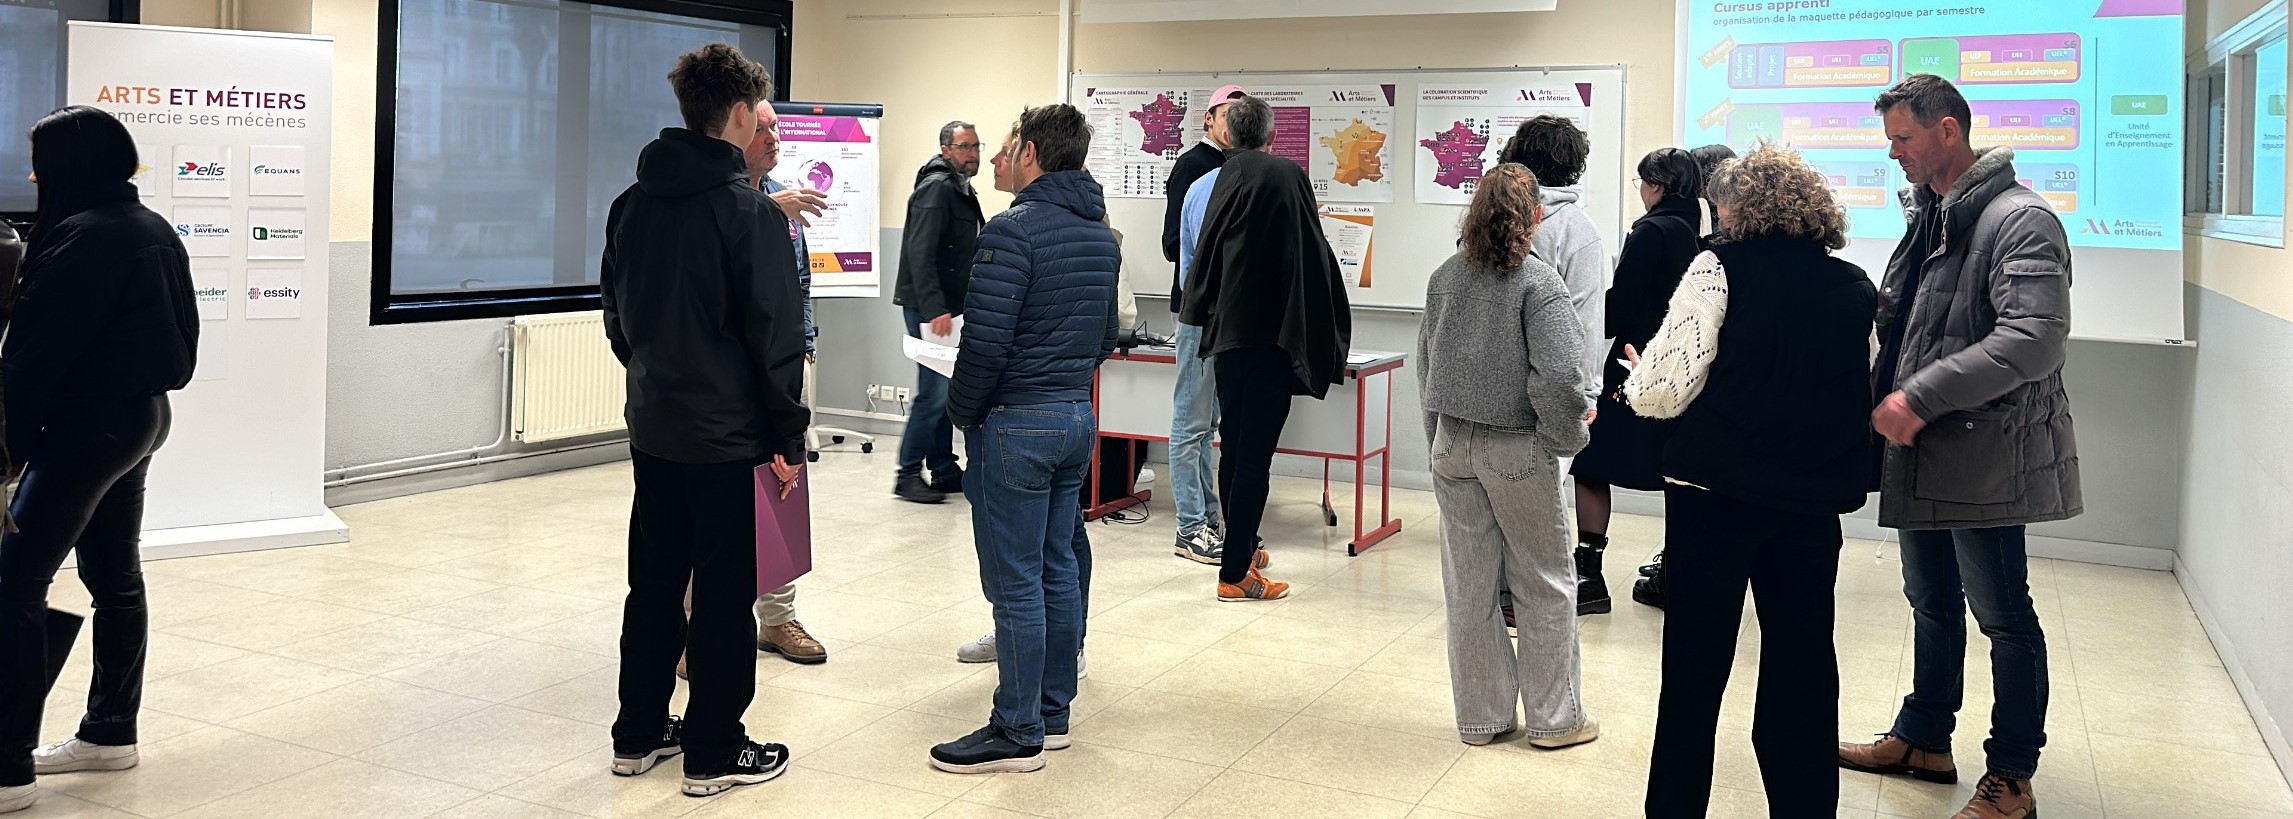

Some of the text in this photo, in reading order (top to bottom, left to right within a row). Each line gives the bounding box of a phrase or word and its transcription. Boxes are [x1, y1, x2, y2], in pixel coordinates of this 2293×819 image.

[1713, 2, 1763, 13] Cursus
[1713, 6, 1986, 27] organisation de la maquette pédagogique par semestre
[2063, 40, 2077, 49] S6
[1876, 46, 1889, 54] S5
[1920, 56, 1941, 66] UAE
[1793, 71, 1881, 83] Formation Académique
[1970, 67, 2068, 79] Formation Académique
[96, 85, 307, 110] ARTS ET MÉTIERS
[2062, 107, 2076, 115] S8
[189, 114, 220, 126] ses
[227, 112, 306, 129] mécènes
[2128, 122, 2150, 130] Unité
[2011, 132, 2066, 143] Académique
[2107, 131, 2171, 140] d'Enseignement
[2116, 140, 2173, 150] Apprentissage
[196, 163, 226, 176] elis
[1873, 169, 1886, 177] S9
[2054, 170, 2076, 180] S10
[1319, 183, 1328, 191] 15
[2114, 219, 2134, 228] Arts
[2114, 228, 2162, 238] et Métiers
[263, 287, 300, 299] essity
[738, 750, 755, 767] N
